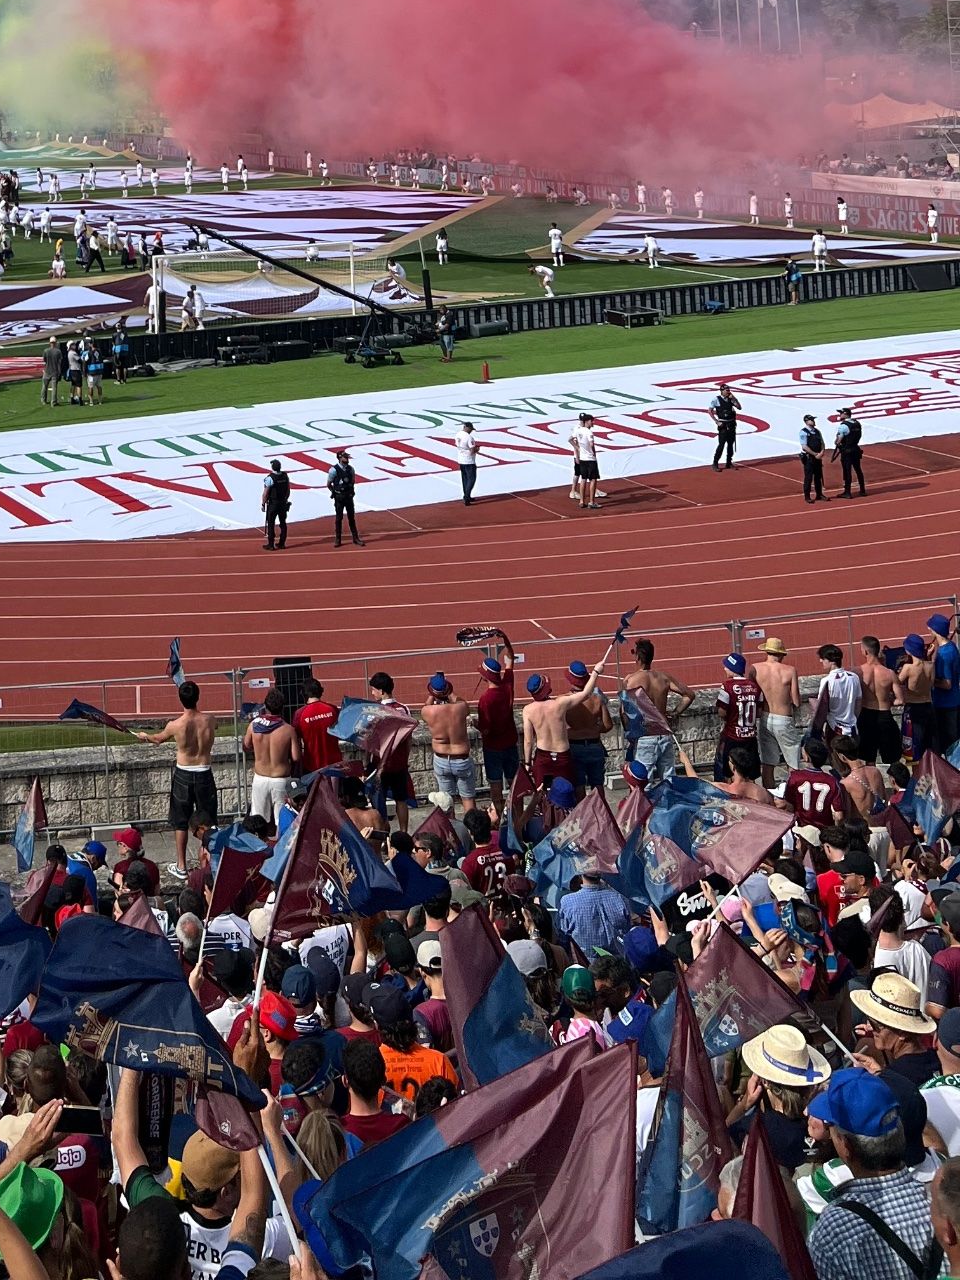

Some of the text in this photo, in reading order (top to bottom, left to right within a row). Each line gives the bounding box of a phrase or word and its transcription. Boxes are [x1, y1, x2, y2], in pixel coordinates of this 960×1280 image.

[867, 208, 928, 235] SAGRES
[736, 701, 757, 727] 10
[797, 780, 830, 812] 17
[222, 932, 241, 940] DER
[187, 1239, 208, 1261] ER
